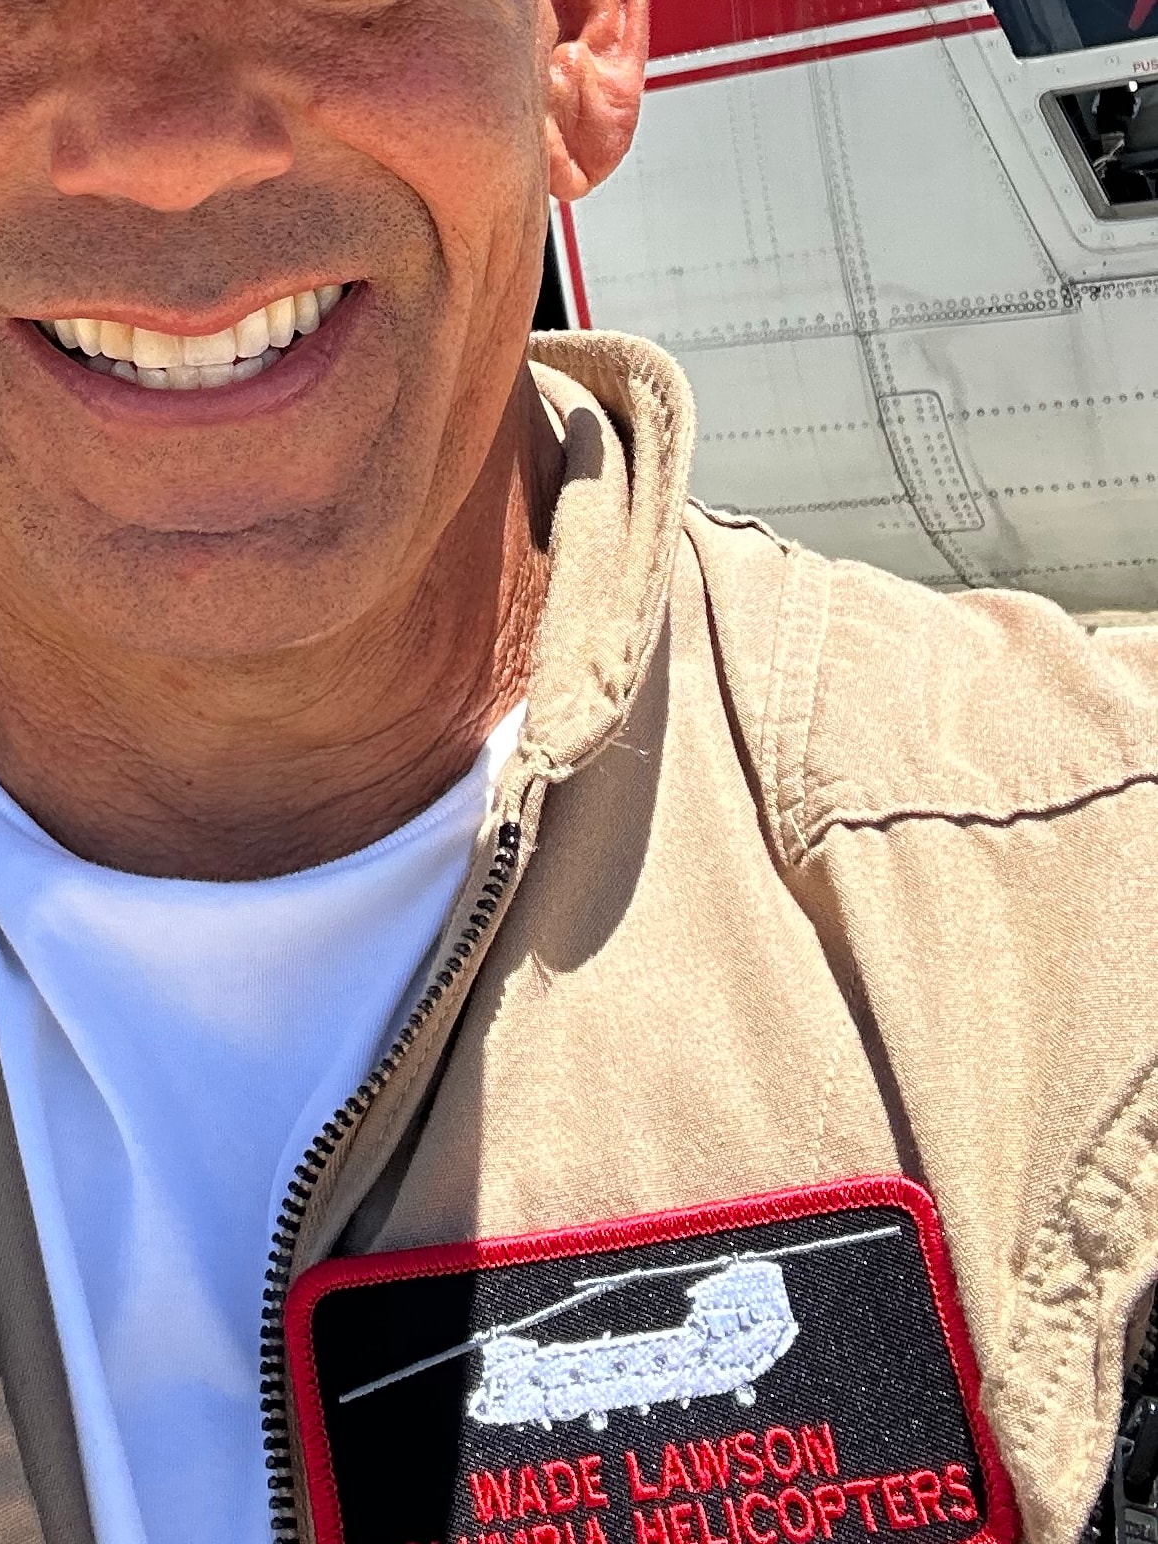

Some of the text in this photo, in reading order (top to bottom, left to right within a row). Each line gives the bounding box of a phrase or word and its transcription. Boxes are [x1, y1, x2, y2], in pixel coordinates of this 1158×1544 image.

[469, 1421, 840, 1524] WADE LAWSON
[632, 1463, 980, 1544] HELICOPTERS
